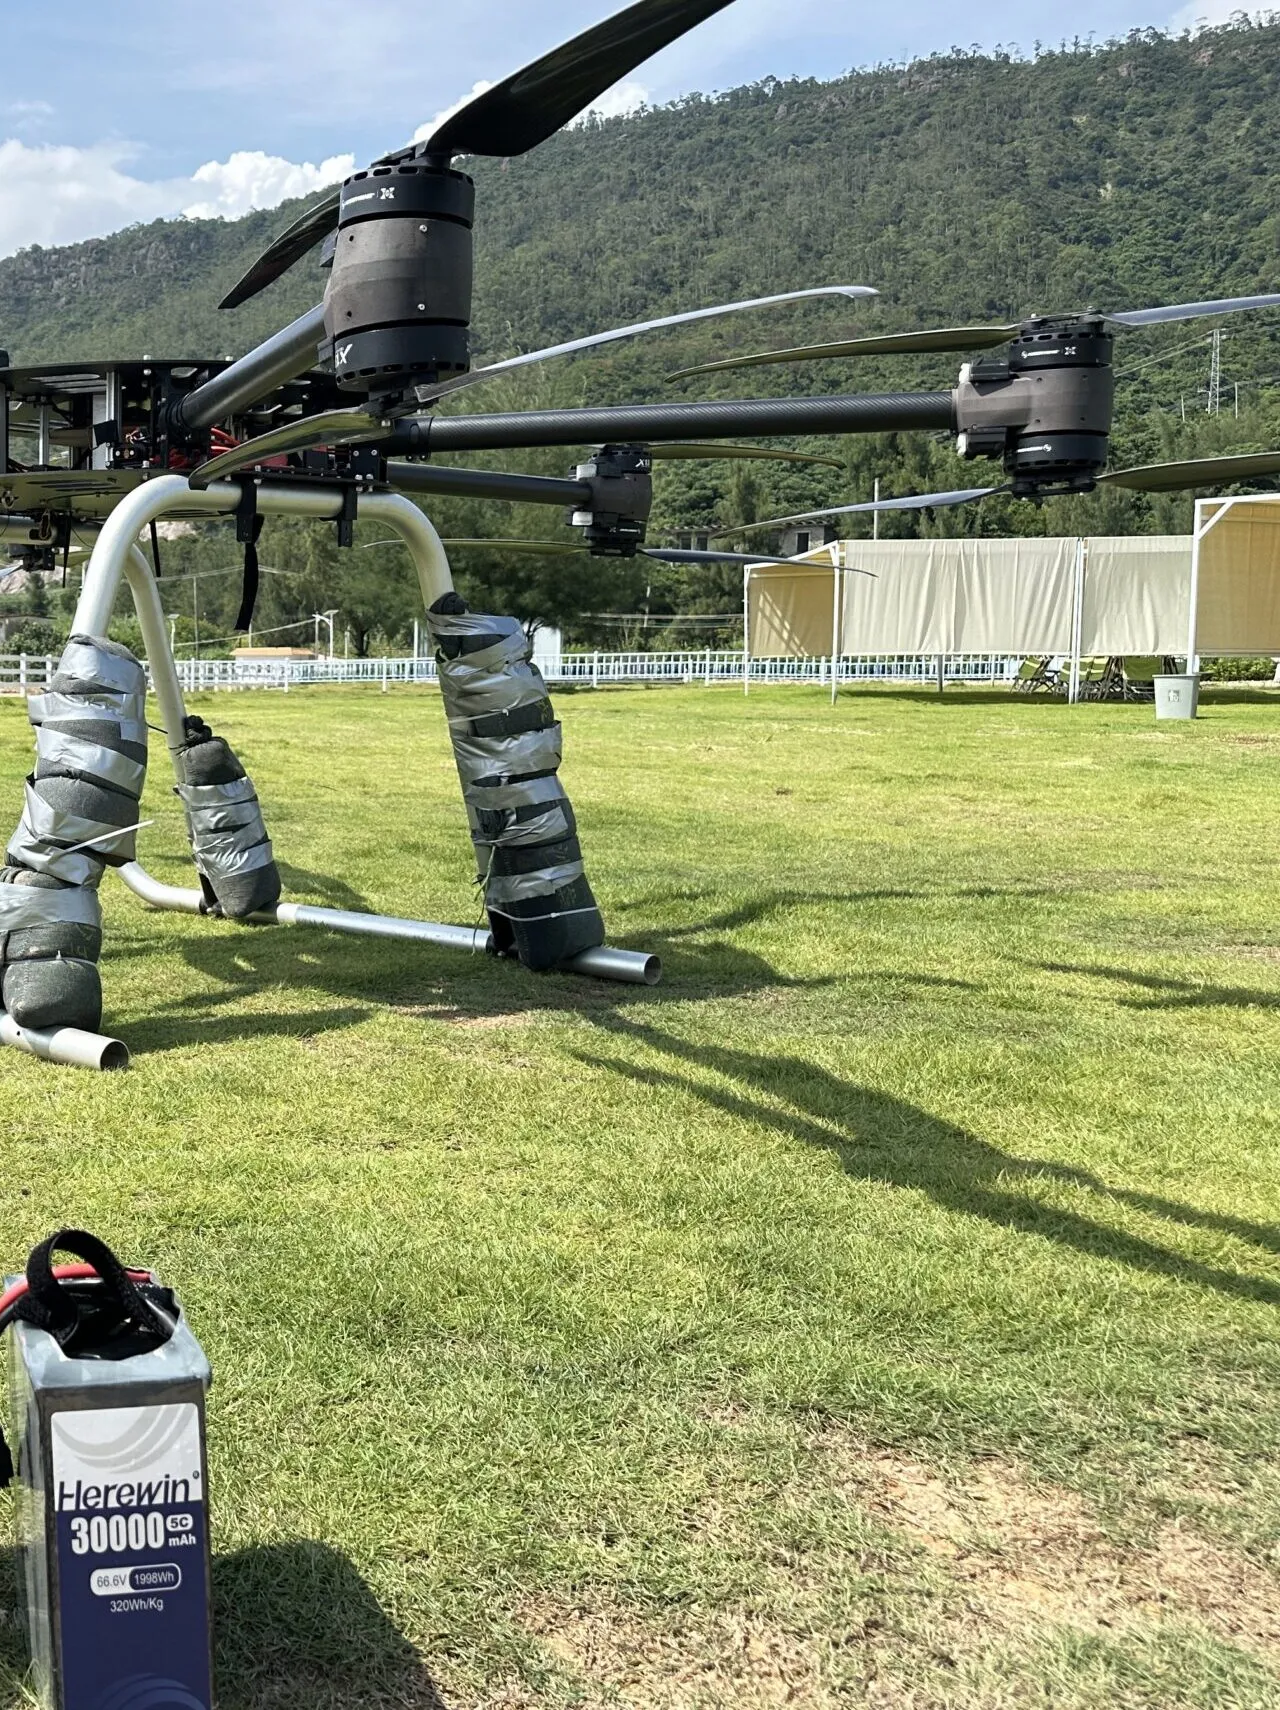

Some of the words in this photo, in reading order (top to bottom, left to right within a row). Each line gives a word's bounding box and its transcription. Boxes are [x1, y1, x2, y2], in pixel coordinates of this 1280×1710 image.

[58, 1473, 190, 1511] Herewin
[71, 1511, 165, 1555] 30000
[169, 1516, 190, 1529] 5C
[168, 1534, 196, 1547] mAh
[96, 1574, 127, 1588] 66.6V
[134, 1571, 175, 1585] 1998Wh
[110, 1597, 164, 1612] 320Wh/Kg
